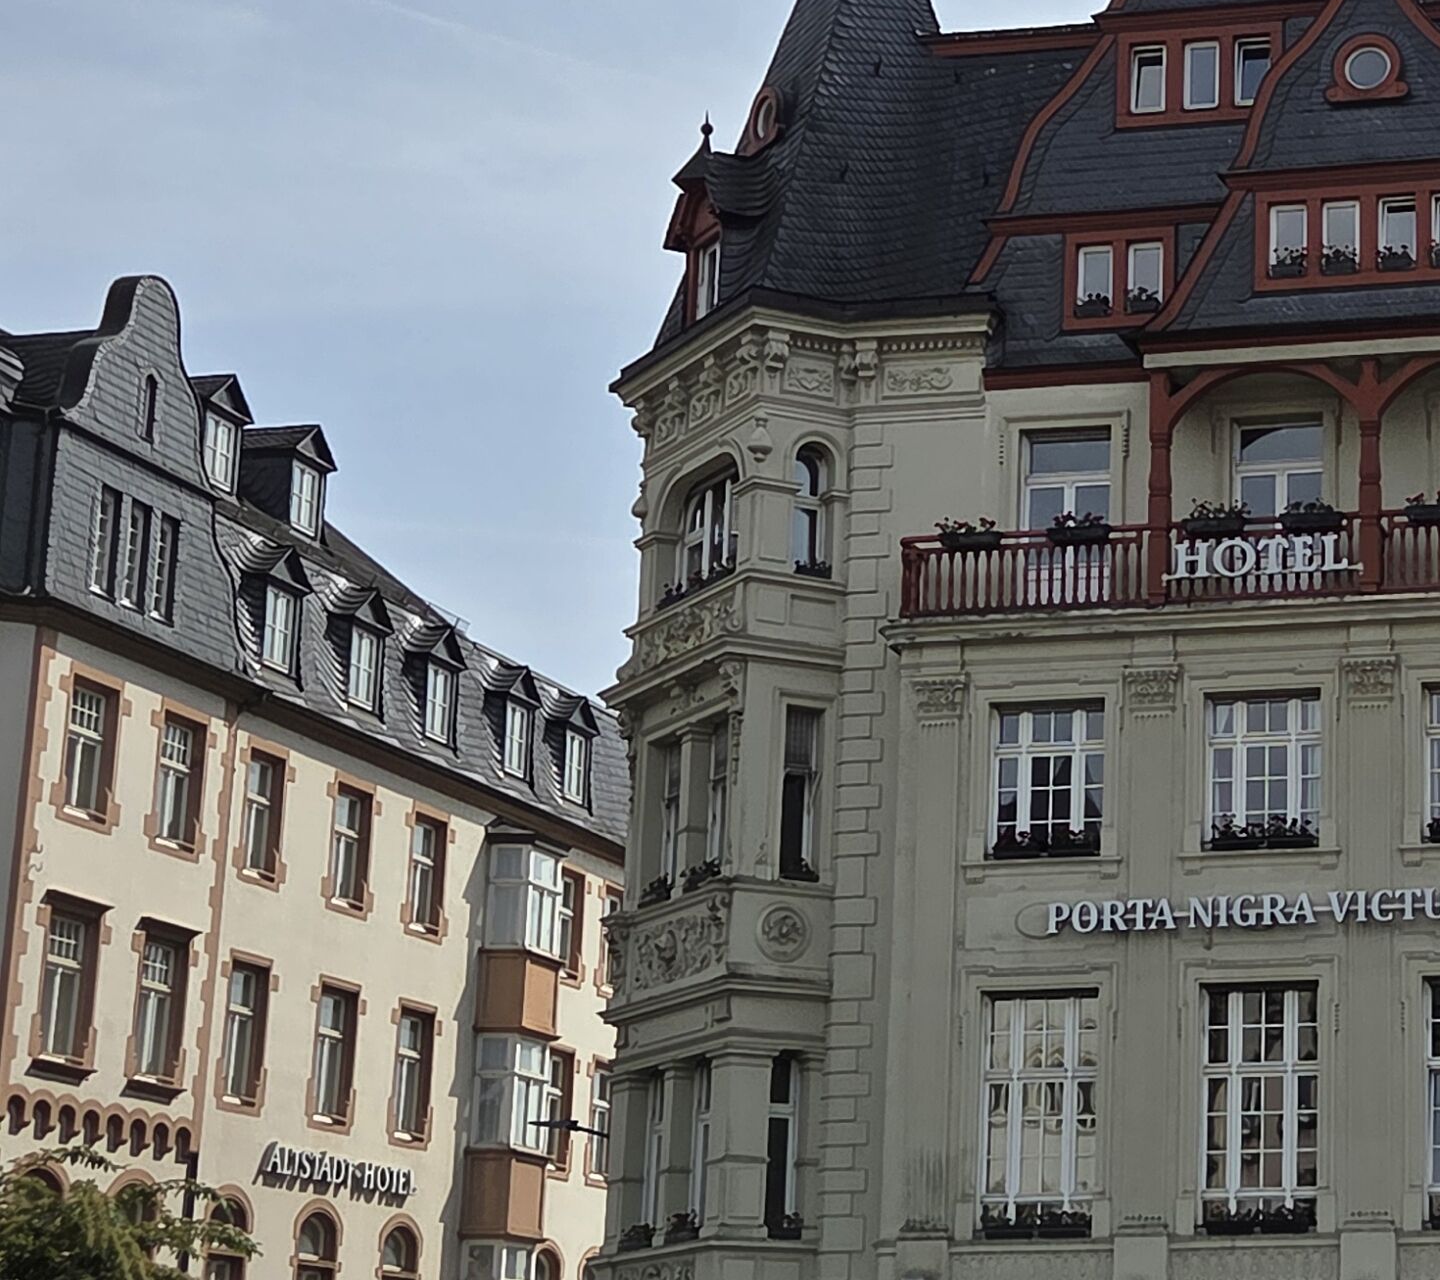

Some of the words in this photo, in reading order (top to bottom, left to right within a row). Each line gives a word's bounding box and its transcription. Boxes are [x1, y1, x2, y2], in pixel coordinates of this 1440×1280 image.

[1174, 534, 1348, 577] HOTEL
[1046, 897, 1177, 934] PORTA
[1188, 893, 1317, 929] NIGRA
